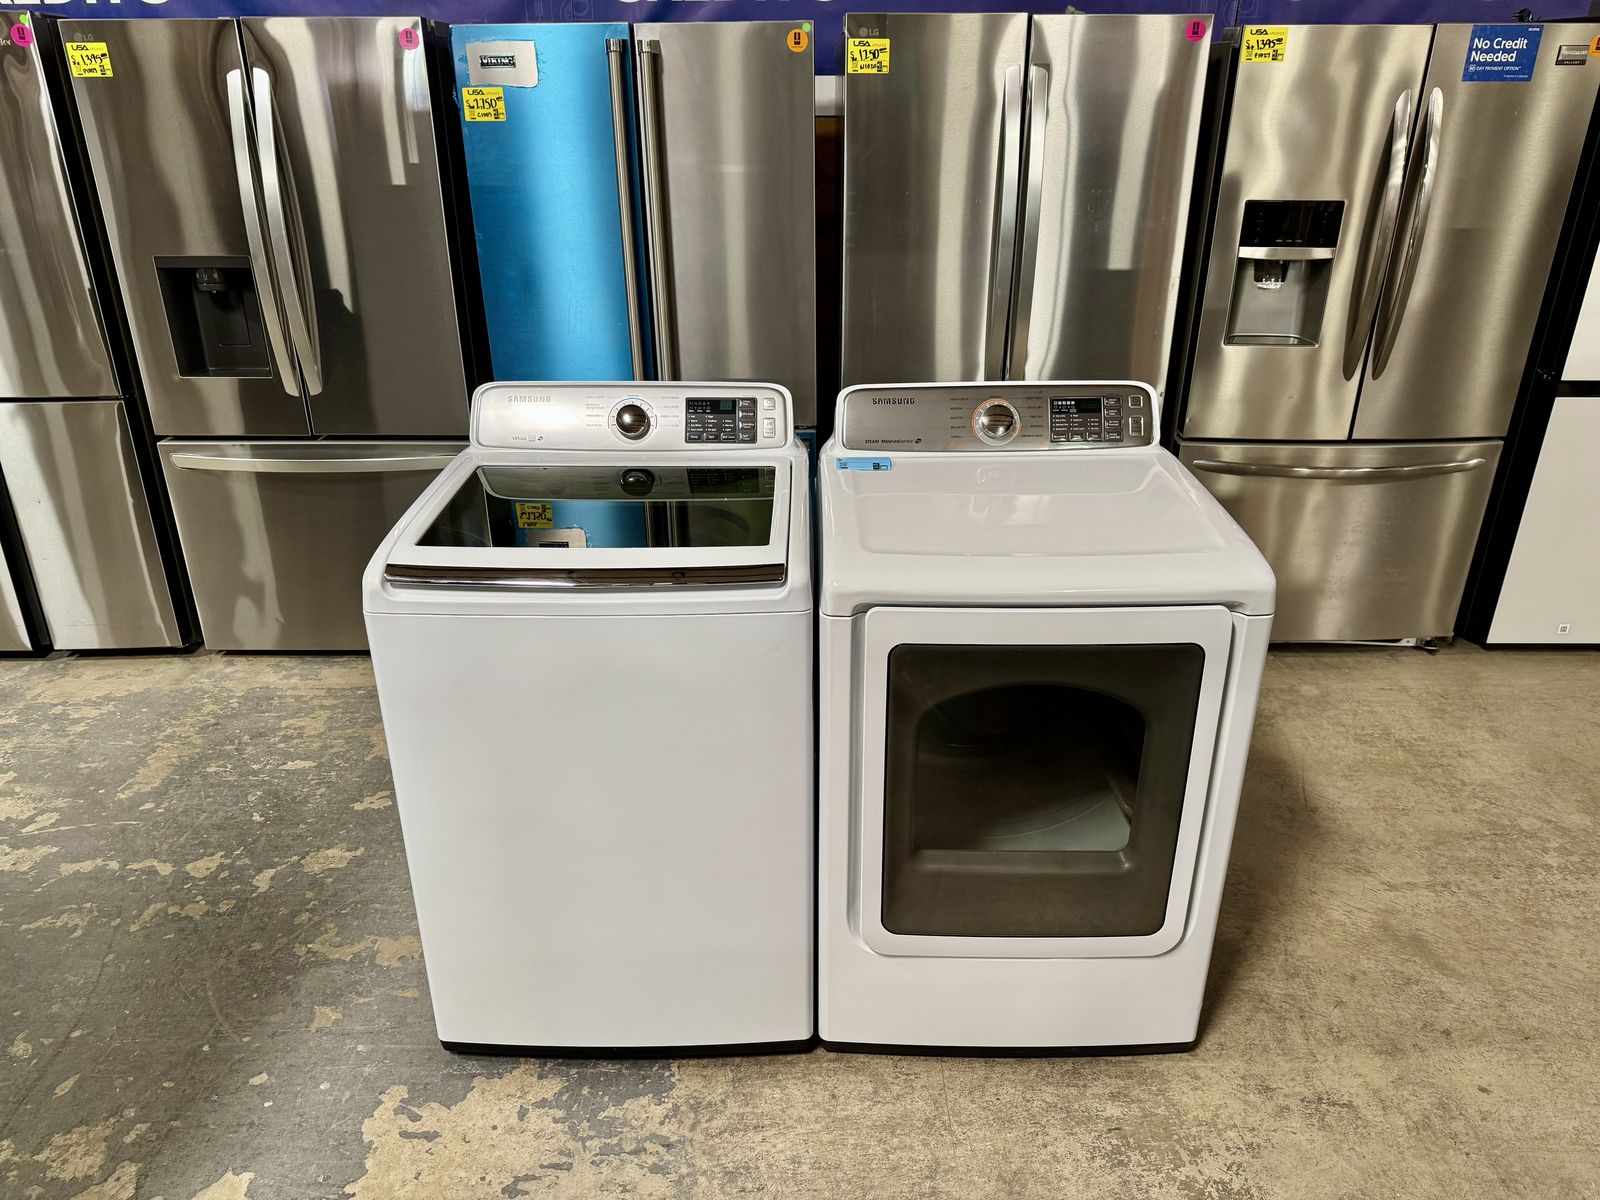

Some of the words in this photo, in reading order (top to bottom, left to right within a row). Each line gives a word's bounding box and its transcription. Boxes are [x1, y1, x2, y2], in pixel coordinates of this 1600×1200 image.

[1472, 37, 1490, 49] No
[1493, 37, 1528, 49] Credit
[1469, 50, 1517, 62] Needed
[507, 395, 552, 403] SAMSUNG
[872, 397, 915, 405] SAMSUNG
